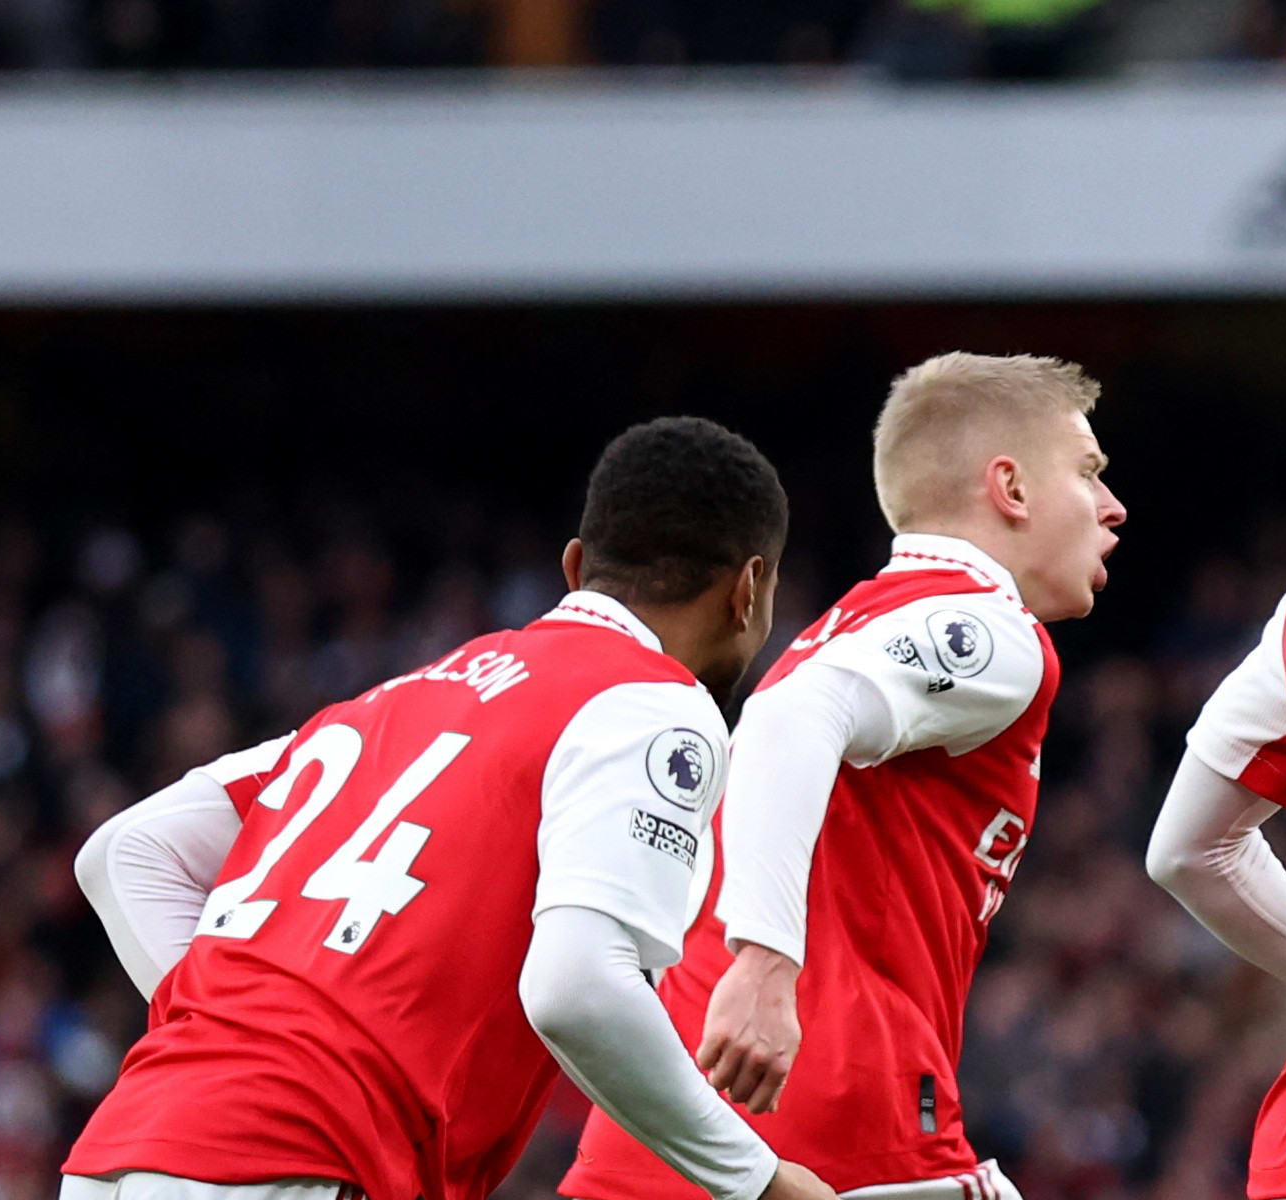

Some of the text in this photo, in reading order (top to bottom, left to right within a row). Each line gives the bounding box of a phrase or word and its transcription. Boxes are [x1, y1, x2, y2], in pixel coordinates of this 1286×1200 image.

[192, 722, 472, 955] 24
[633, 808, 697, 854] No room
